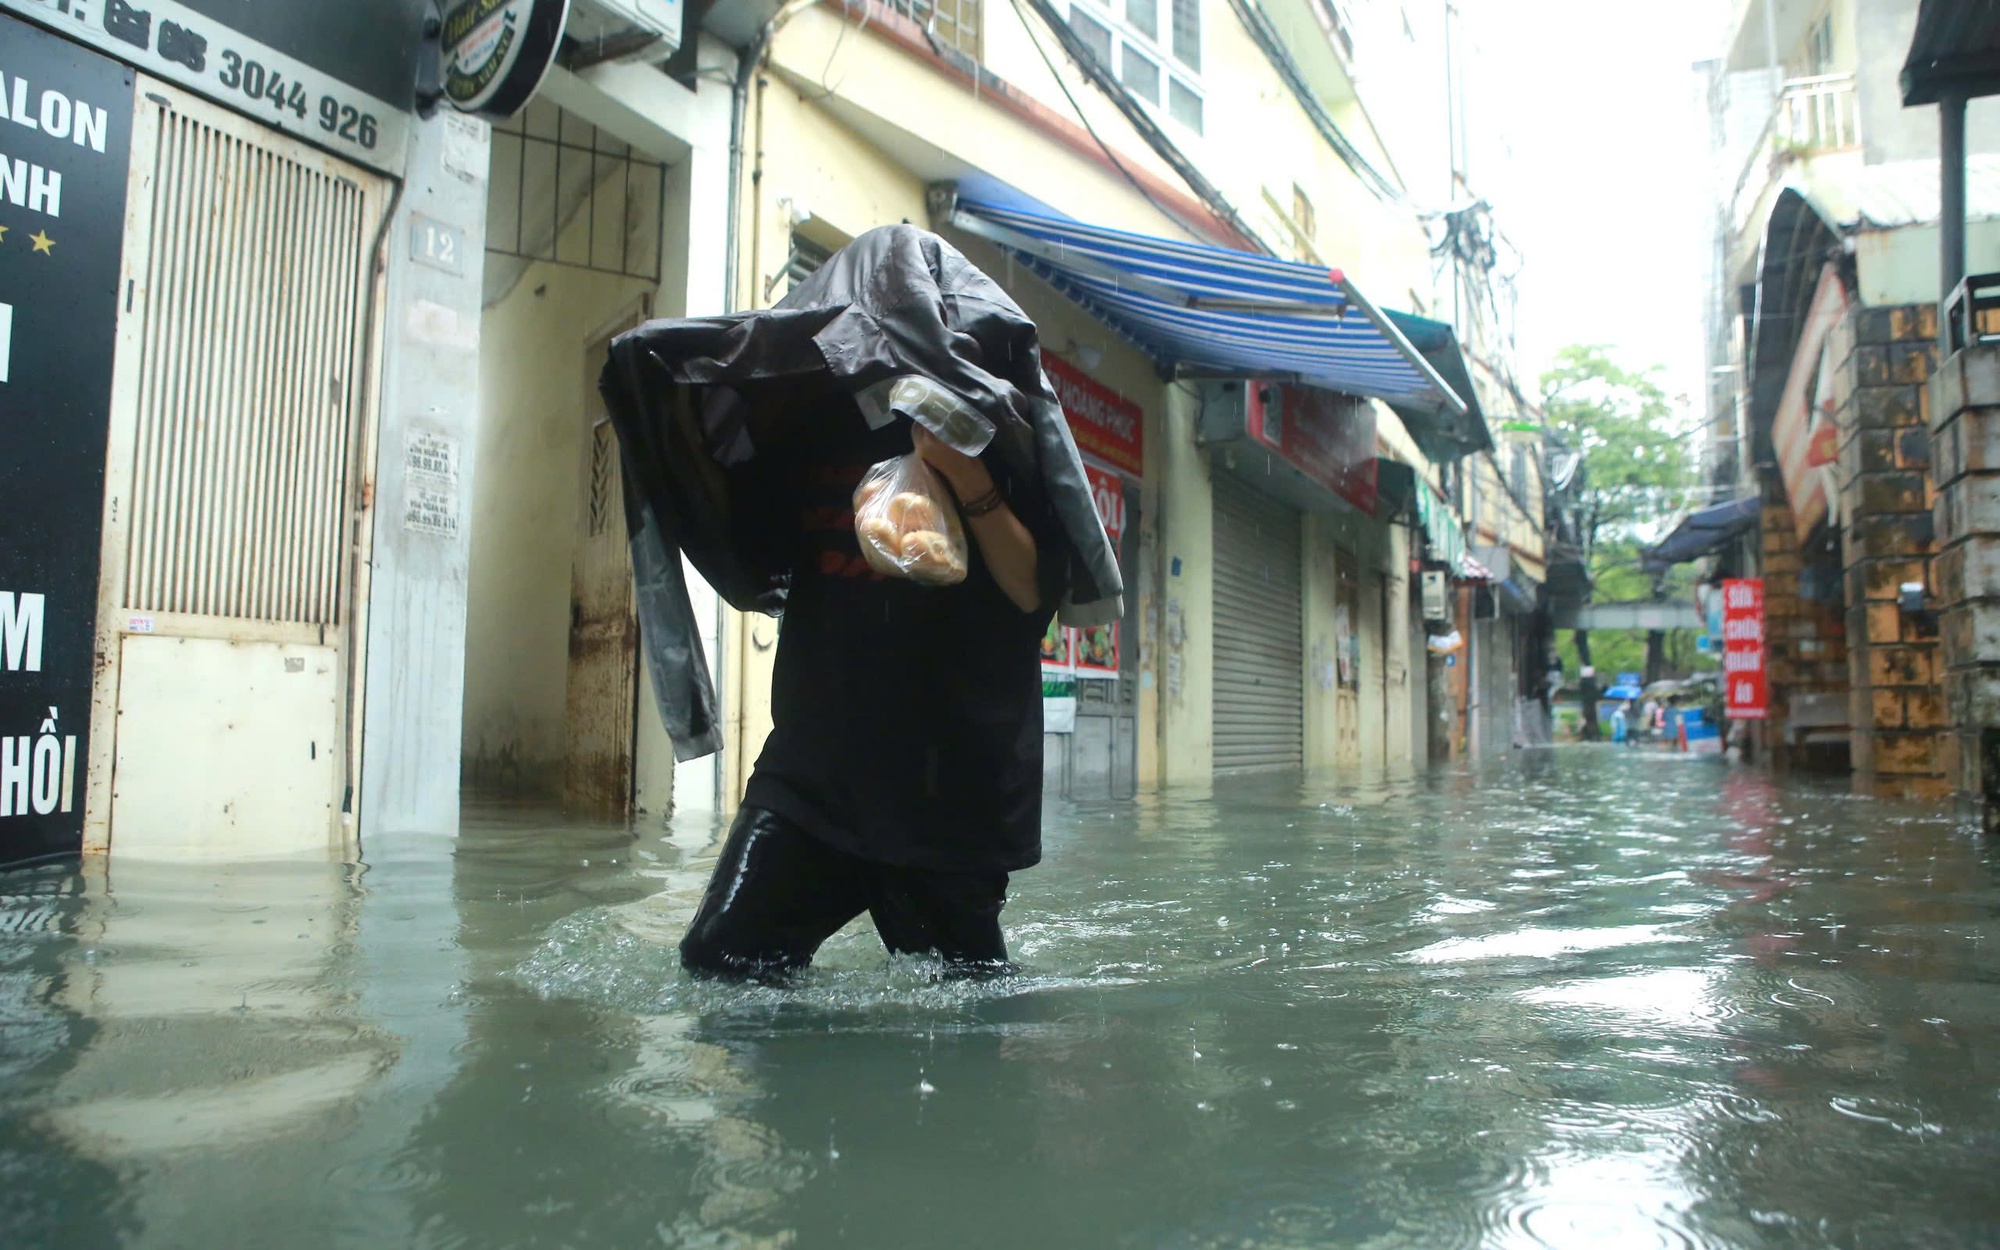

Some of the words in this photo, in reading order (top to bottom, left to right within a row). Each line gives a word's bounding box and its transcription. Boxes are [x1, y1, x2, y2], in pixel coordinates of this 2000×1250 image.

[219, 49, 307, 119] 3044
[319, 95, 378, 149] 926
[426, 227, 454, 264] 12
[1090, 475, 1121, 532] ÔI
[0, 706, 76, 817] HỒI
